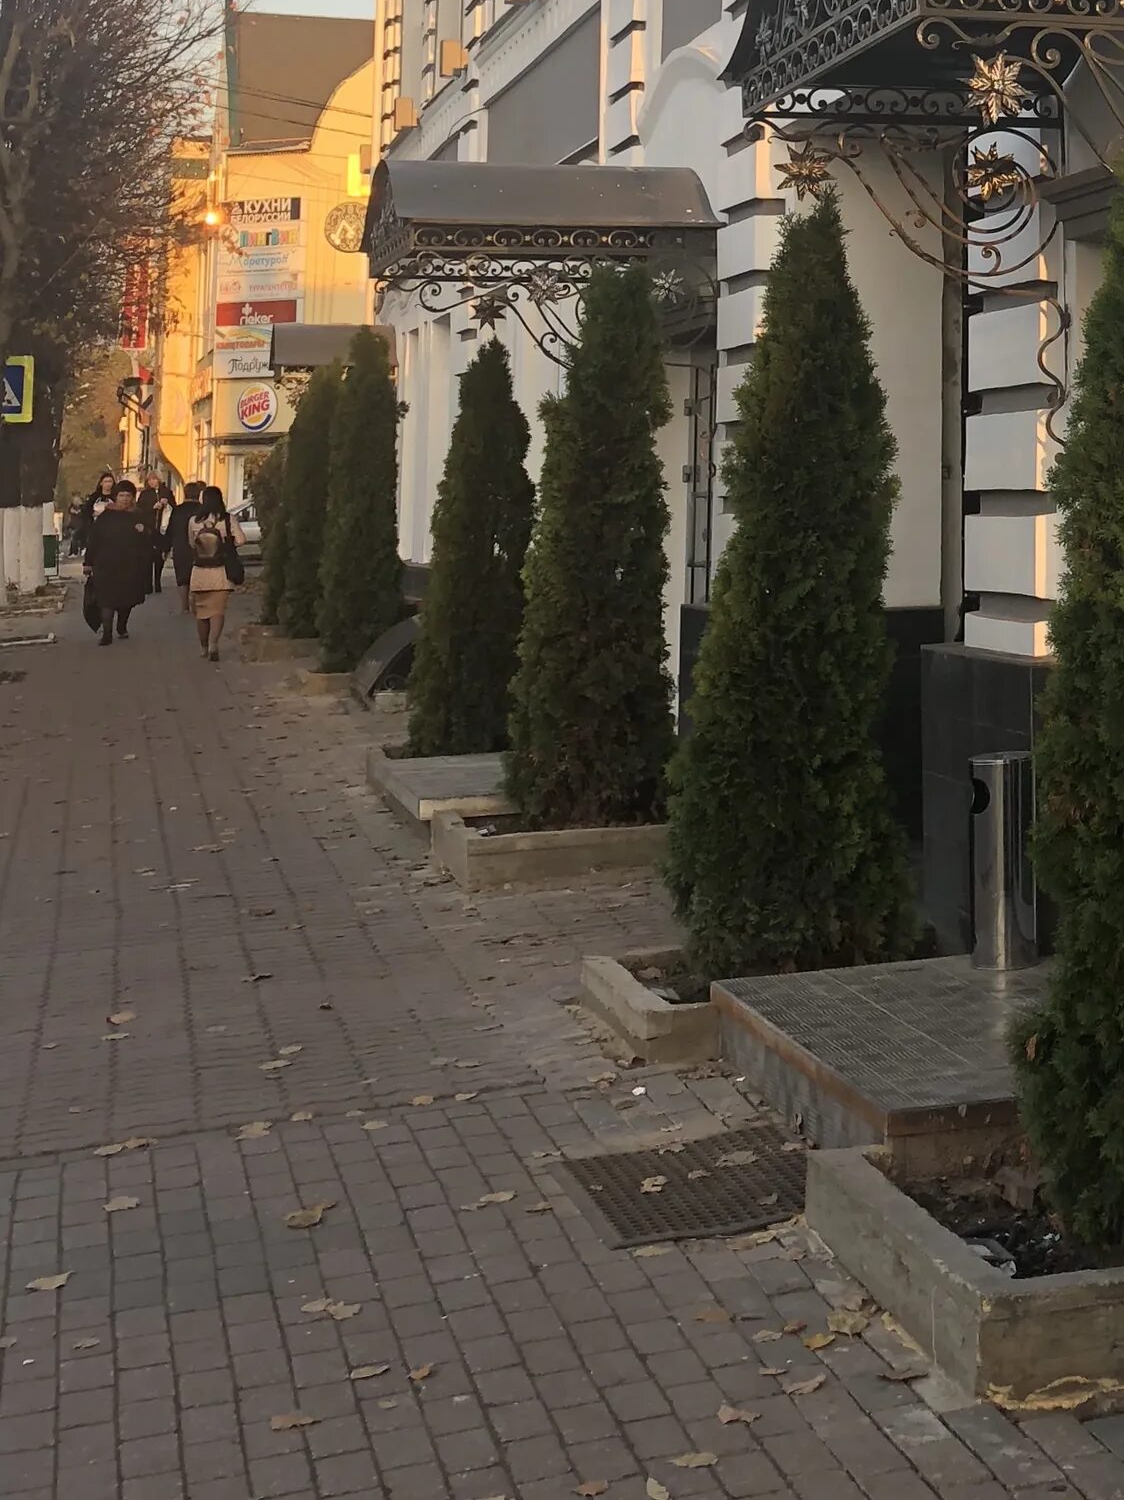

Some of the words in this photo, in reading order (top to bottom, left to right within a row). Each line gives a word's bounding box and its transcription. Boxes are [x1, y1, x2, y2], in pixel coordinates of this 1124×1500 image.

[244, 199, 291, 213] КУХНИ
[230, 212, 291, 224] БЕЛОРУССИИ
[239, 313, 274, 325] rieker
[240, 391, 270, 408] BURGER
[240, 400, 270, 420] KING
